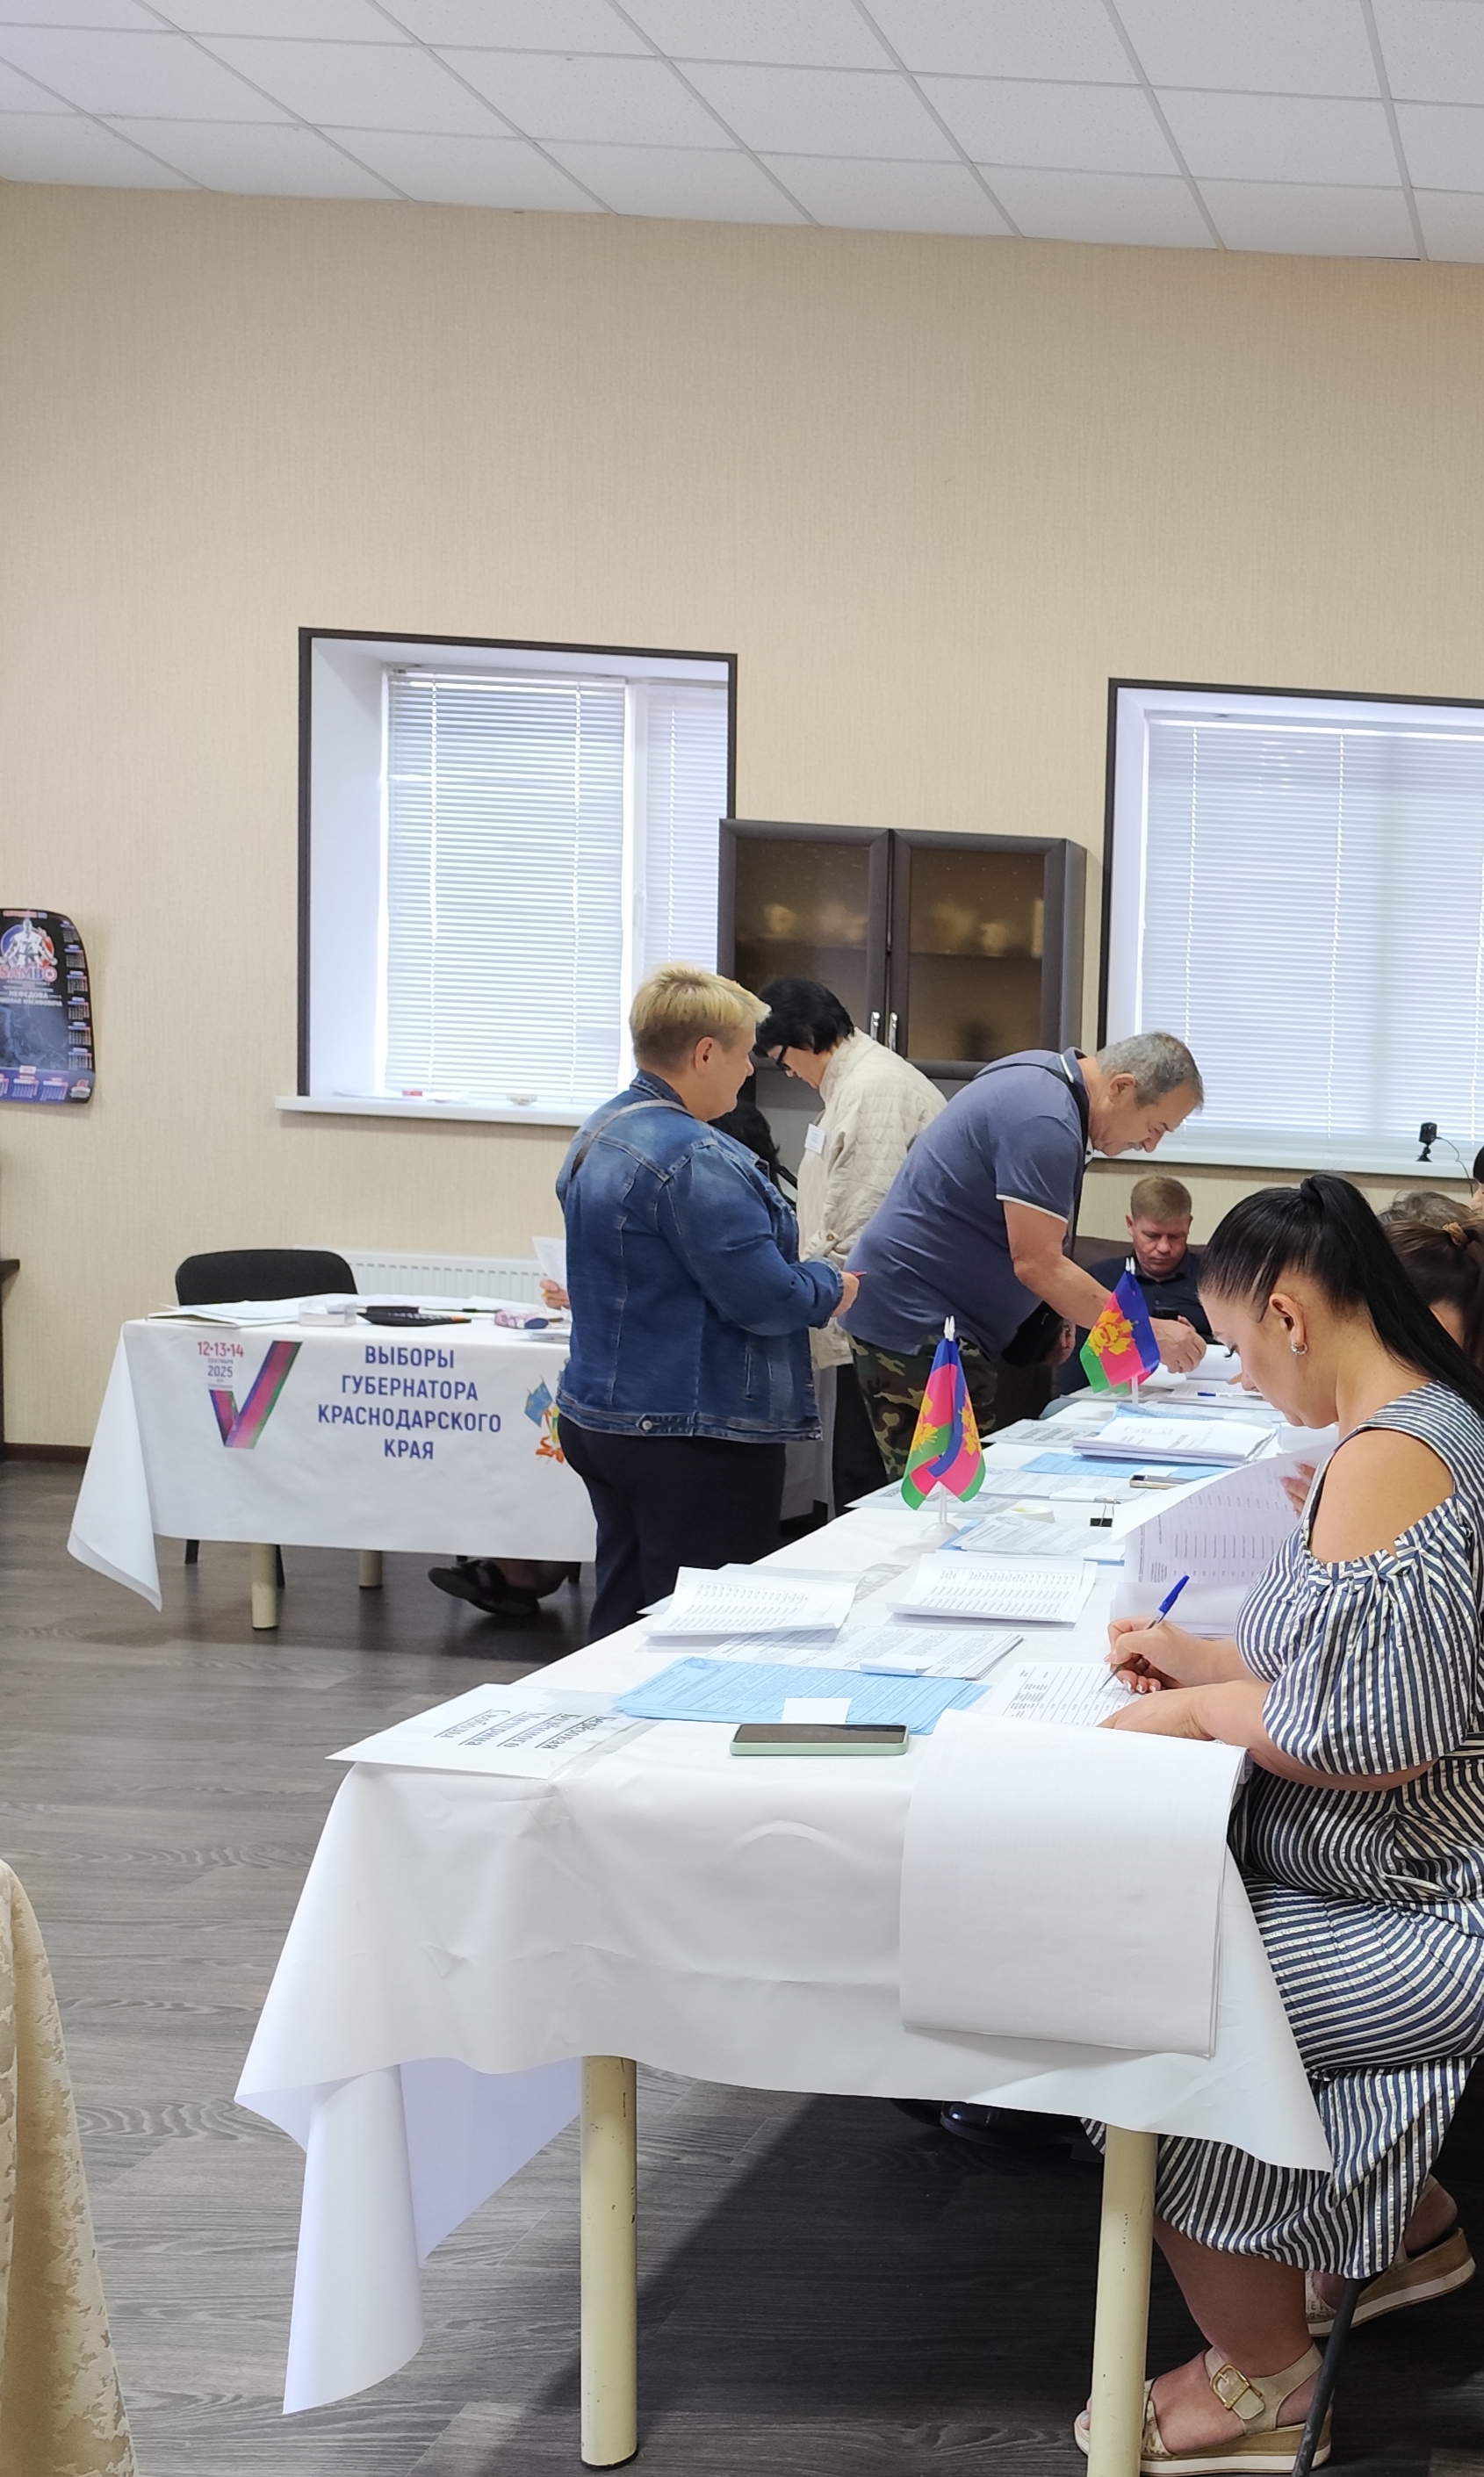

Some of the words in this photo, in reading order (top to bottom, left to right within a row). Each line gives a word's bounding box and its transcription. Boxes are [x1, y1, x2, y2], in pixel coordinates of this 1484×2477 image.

[364, 1345, 455, 1369] ВЫБОРЫ
[207, 1365, 234, 1379] 2025
[341, 1375, 479, 1401] ГУБЕРНАТОРА
[318, 1405, 502, 1433] КРАСНОДАРСКОГО
[384, 1438, 435, 1460] КРАЯ
